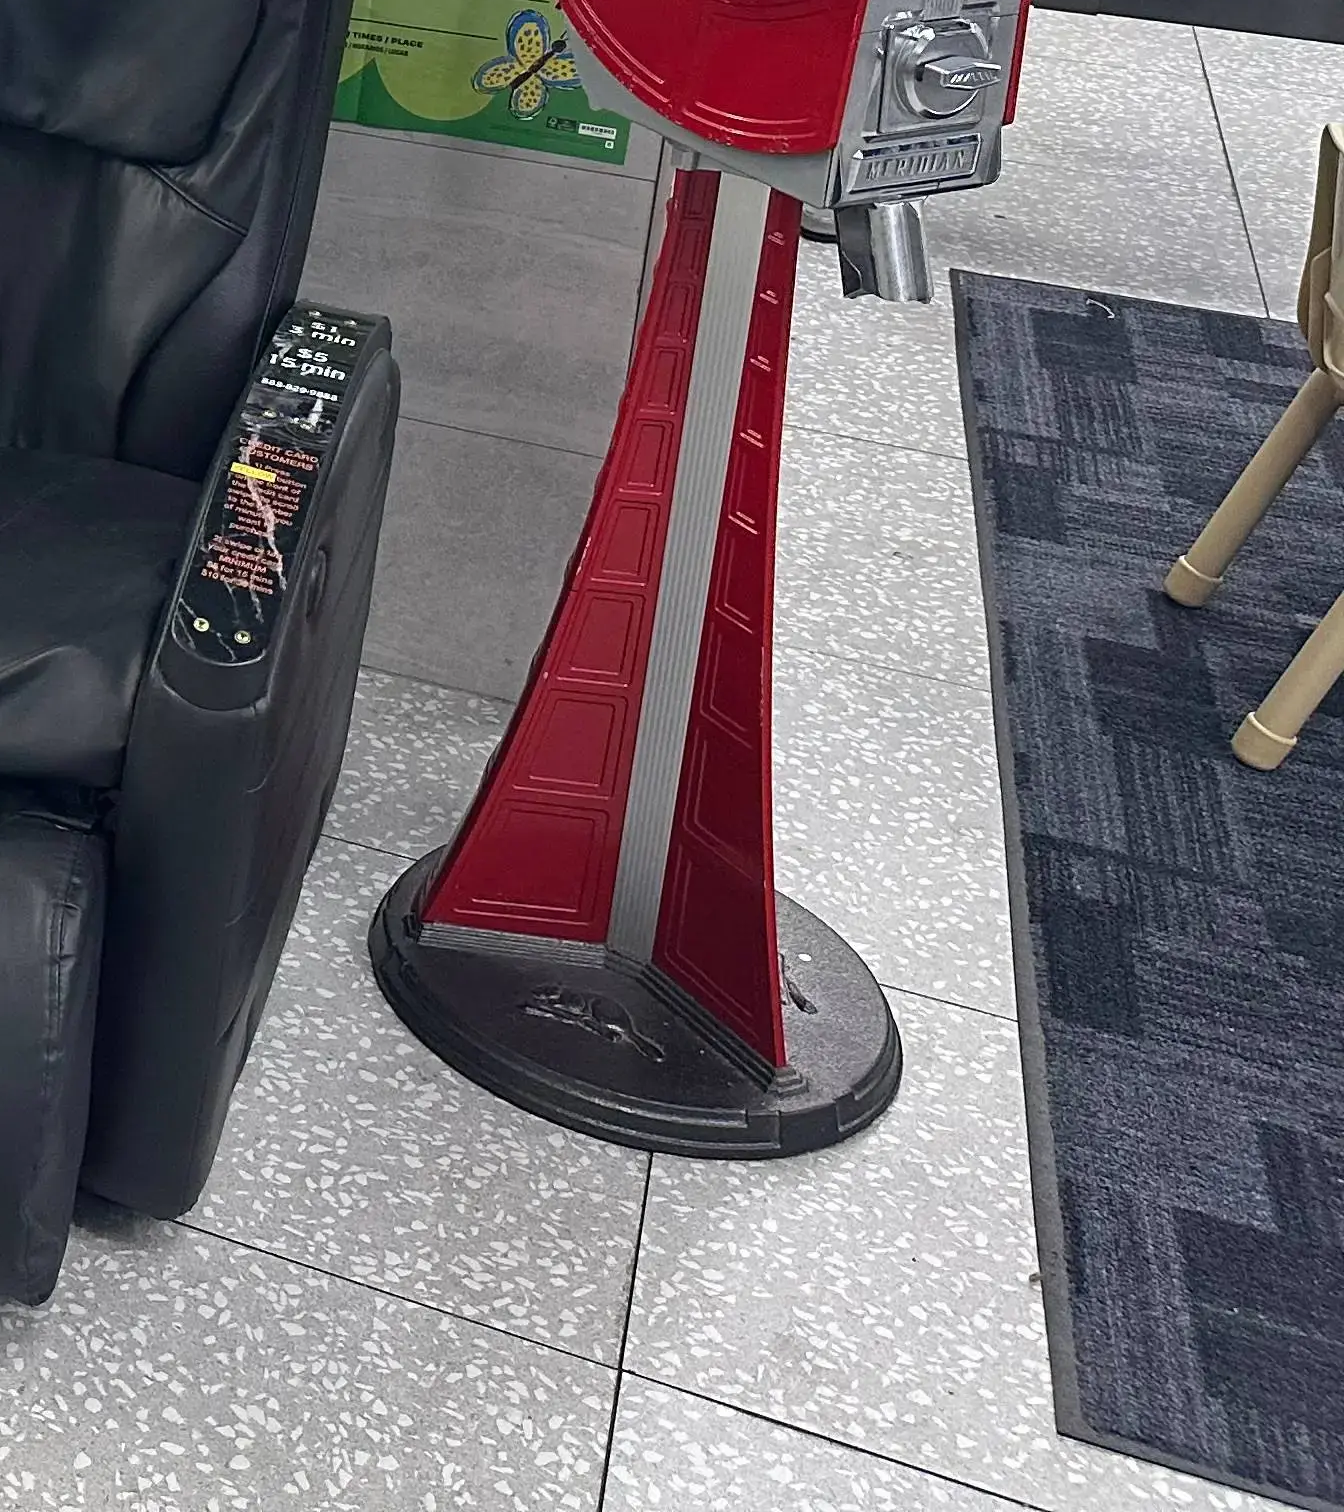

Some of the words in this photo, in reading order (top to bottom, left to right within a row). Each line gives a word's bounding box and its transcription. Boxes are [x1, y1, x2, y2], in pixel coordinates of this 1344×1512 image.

[352, 32, 383, 42] TIMES
[391, 37, 424, 48] PLACE
[866, 151, 969, 181] MERIDIAN
[311, 321, 338, 333] $1
[288, 325, 305, 336] 3
[312, 331, 356, 347] min
[297, 348, 329, 363] $5
[284, 449, 319, 463] CARD
[219, 555, 267, 574] MINIMUM
